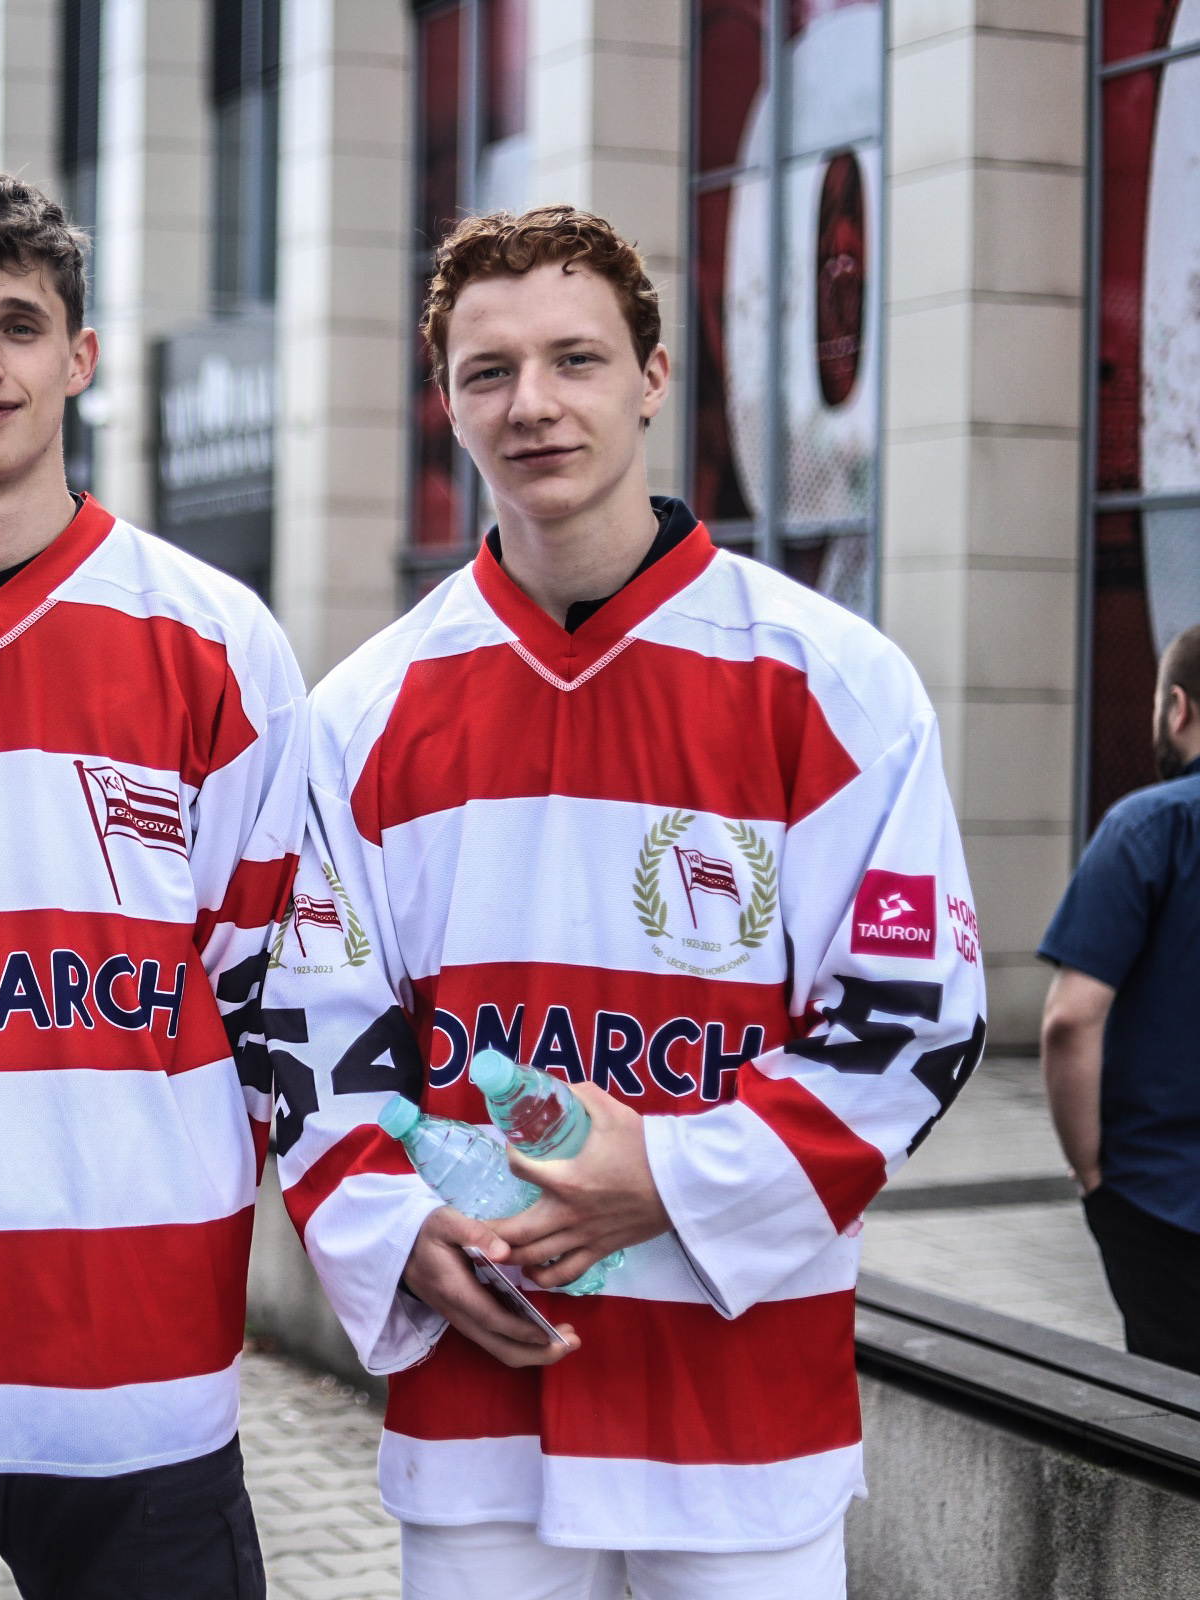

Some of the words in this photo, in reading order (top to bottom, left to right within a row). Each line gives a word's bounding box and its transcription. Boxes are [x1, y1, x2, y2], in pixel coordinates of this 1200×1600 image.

[857, 922, 931, 942] TAURON
[681, 937, 721, 953] 1923-2023
[953, 926, 977, 968] LIGA
[293, 965, 334, 975] 1923-2023
[428, 1003, 765, 1101] OMARCH
